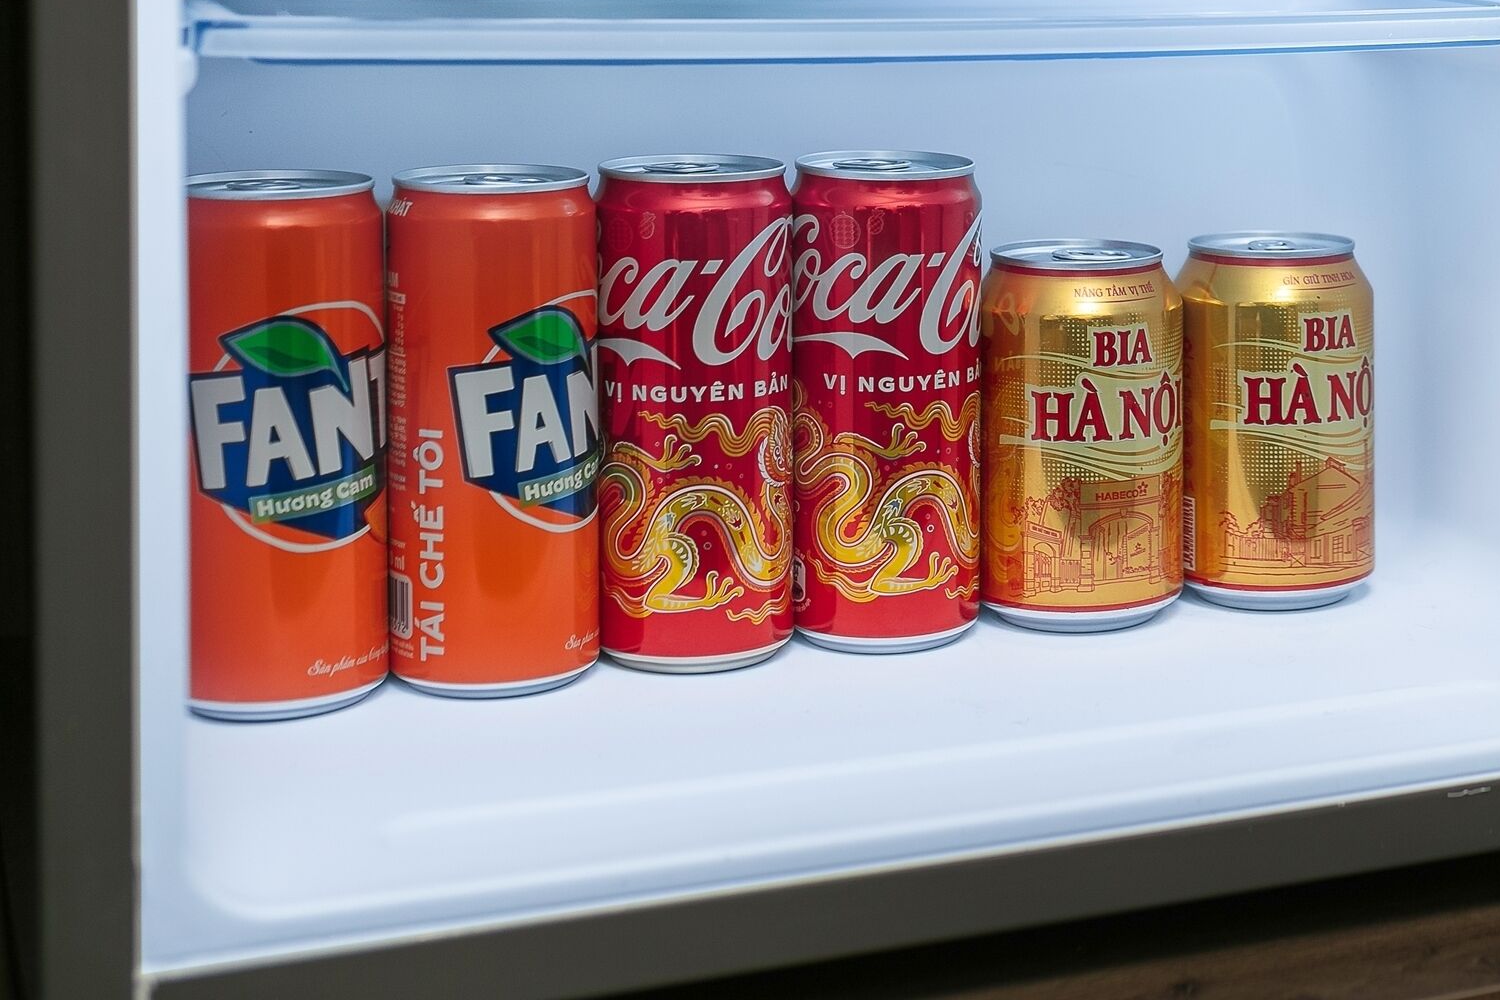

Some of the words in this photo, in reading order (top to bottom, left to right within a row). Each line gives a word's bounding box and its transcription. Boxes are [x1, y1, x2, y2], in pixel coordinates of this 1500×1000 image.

[1074, 287, 1104, 298] NÂNG
[1106, 284, 1128, 297] TẦM
[1128, 285, 1138, 296] VỊ
[1139, 281, 1155, 295] THẾ
[1322, 273, 1340, 284] TINH
[1093, 328, 1152, 367] BIA
[1304, 314, 1356, 352] BIA
[604, 380, 622, 403] VỊ
[632, 380, 748, 403] NGUYÊN
[754, 371, 788, 398] BẢN
[824, 373, 846, 396] VỊ
[858, 369, 960, 393] NGUYÊN
[966, 358, 982, 384] BẢ
[1243, 363, 1322, 425] HÀ
[1328, 356, 1374, 428] NỘ
[1031, 378, 1112, 442] HÀ
[412, 428, 444, 495] TÔI
[256, 486, 334, 517] Hương
[336, 473, 374, 499] Cam
[524, 468, 583, 502] Hương
[1096, 489, 1139, 502] HABECO
[410, 500, 444, 590] CHẾ
[414, 601, 444, 662] TÁI
